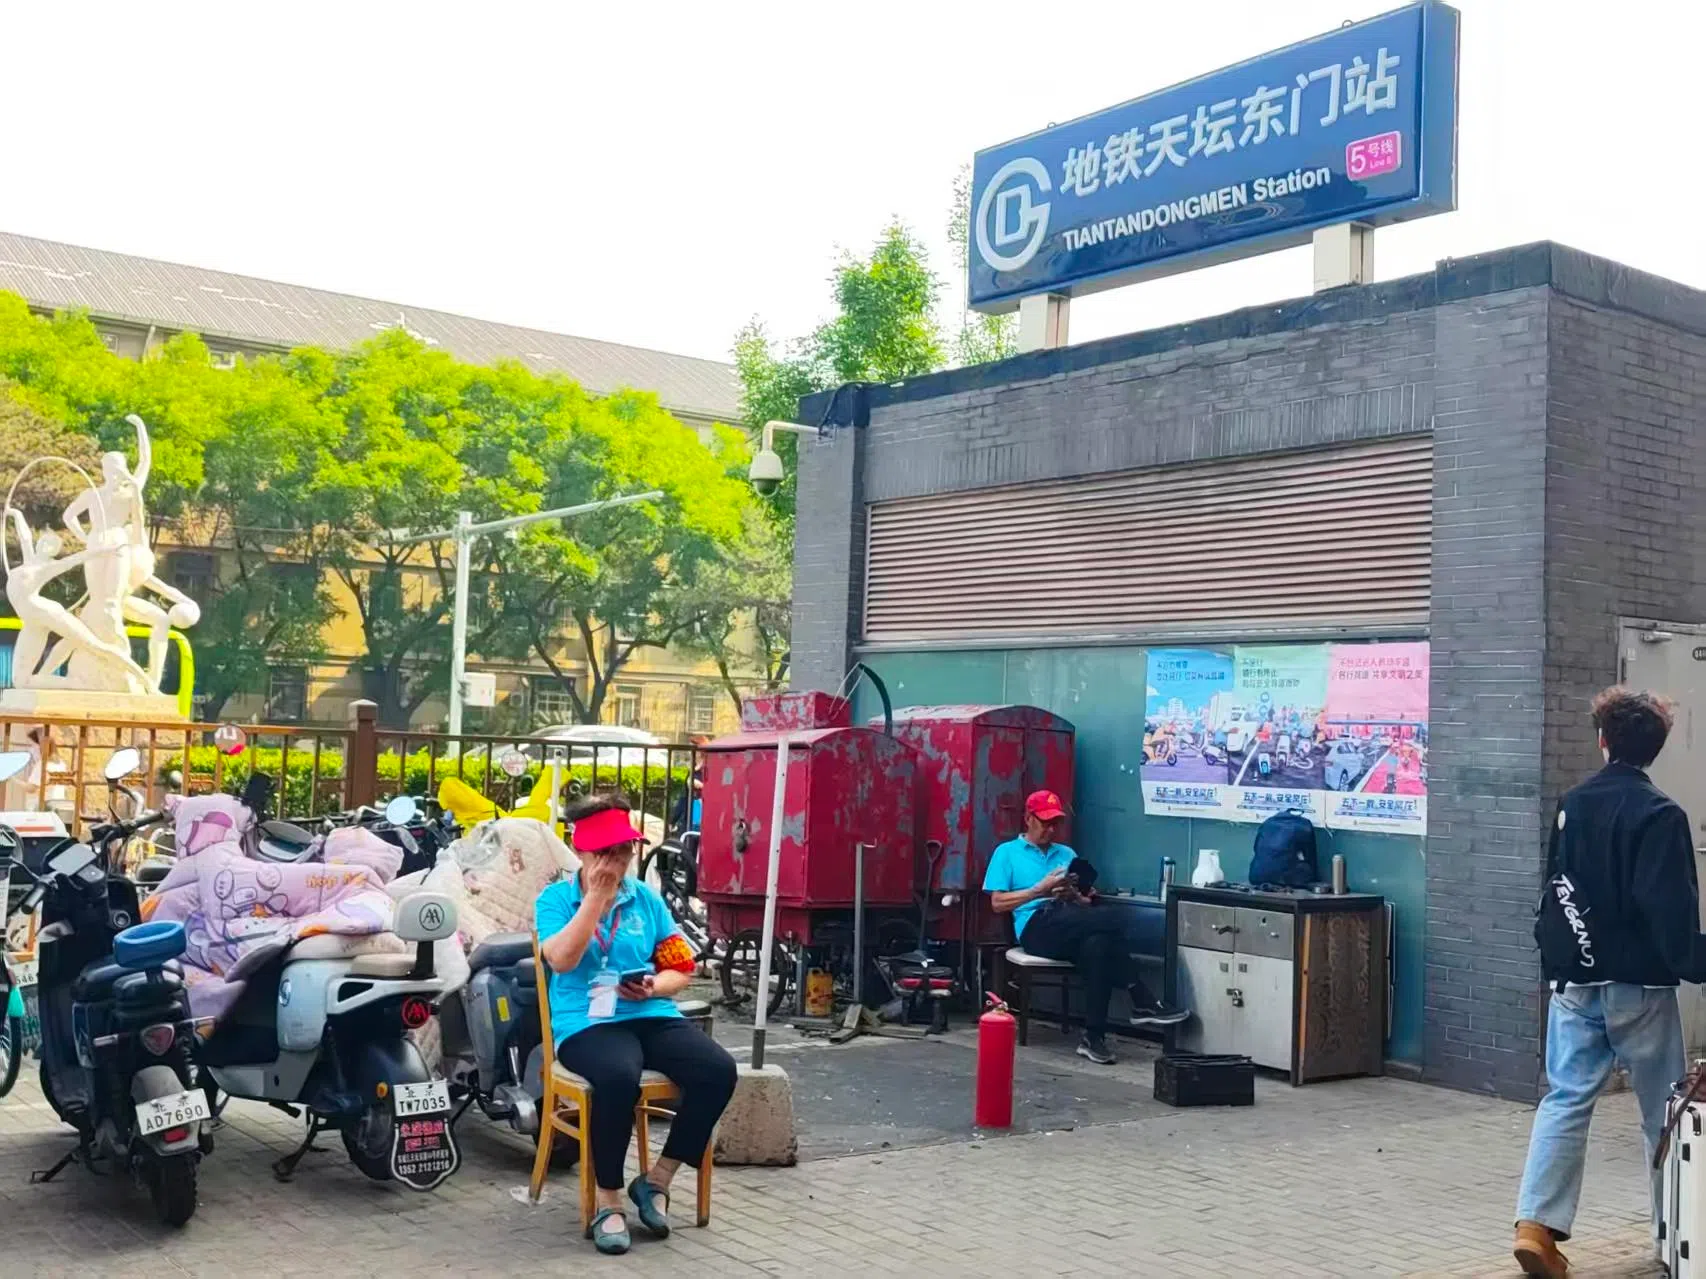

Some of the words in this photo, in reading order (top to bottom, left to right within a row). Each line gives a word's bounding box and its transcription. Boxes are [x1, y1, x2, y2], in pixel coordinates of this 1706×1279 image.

[1060, 48, 1400, 197] 地铁天坛东门站
[1063, 183, 1248, 251] TIANTANDONGMEN
[1253, 167, 1332, 201] Station
[145, 1104, 204, 1132] AD7690
[398, 1095, 446, 1113] TW7035
